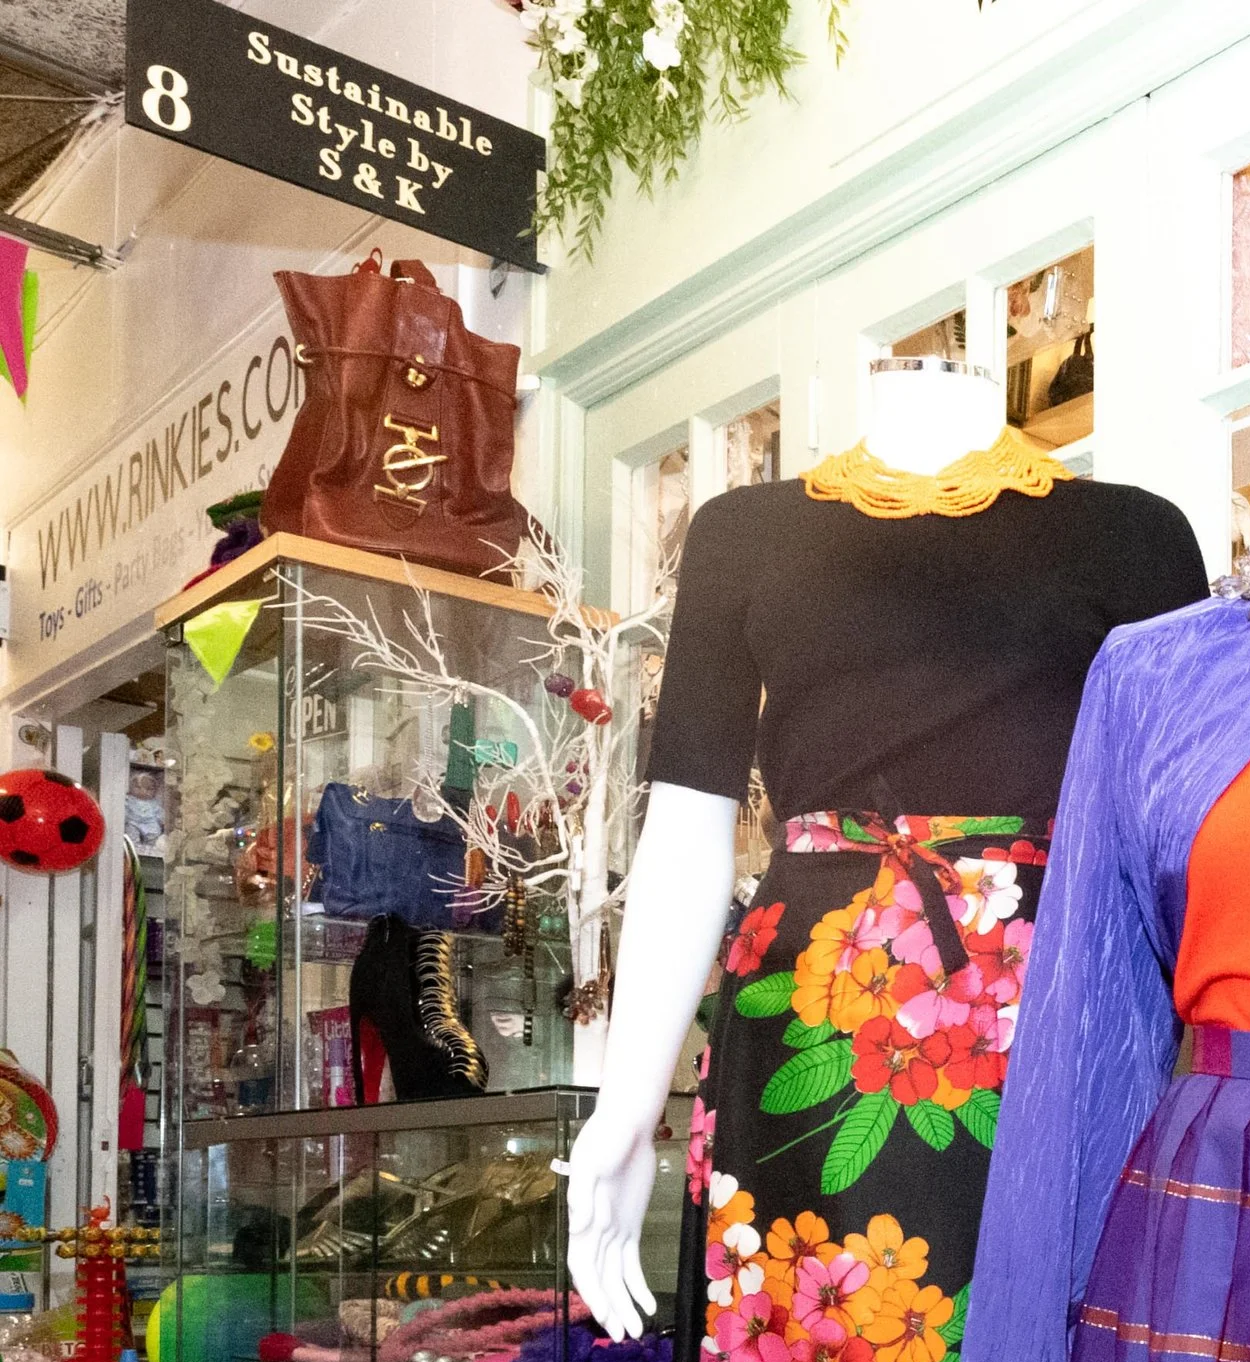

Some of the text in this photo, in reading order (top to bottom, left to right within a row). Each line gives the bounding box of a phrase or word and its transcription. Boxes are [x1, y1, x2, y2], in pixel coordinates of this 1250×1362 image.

[141, 64, 192, 132] 8
[247, 31, 493, 156] Sustainable
[290, 93, 453, 190] Style by
[318, 147, 426, 215] S & K
[38, 335, 299, 591] WWW.RINKIES.CO
[39, 605, 65, 642] Toys
[75, 577, 104, 619] Gifts
[114, 549, 149, 597] Party
